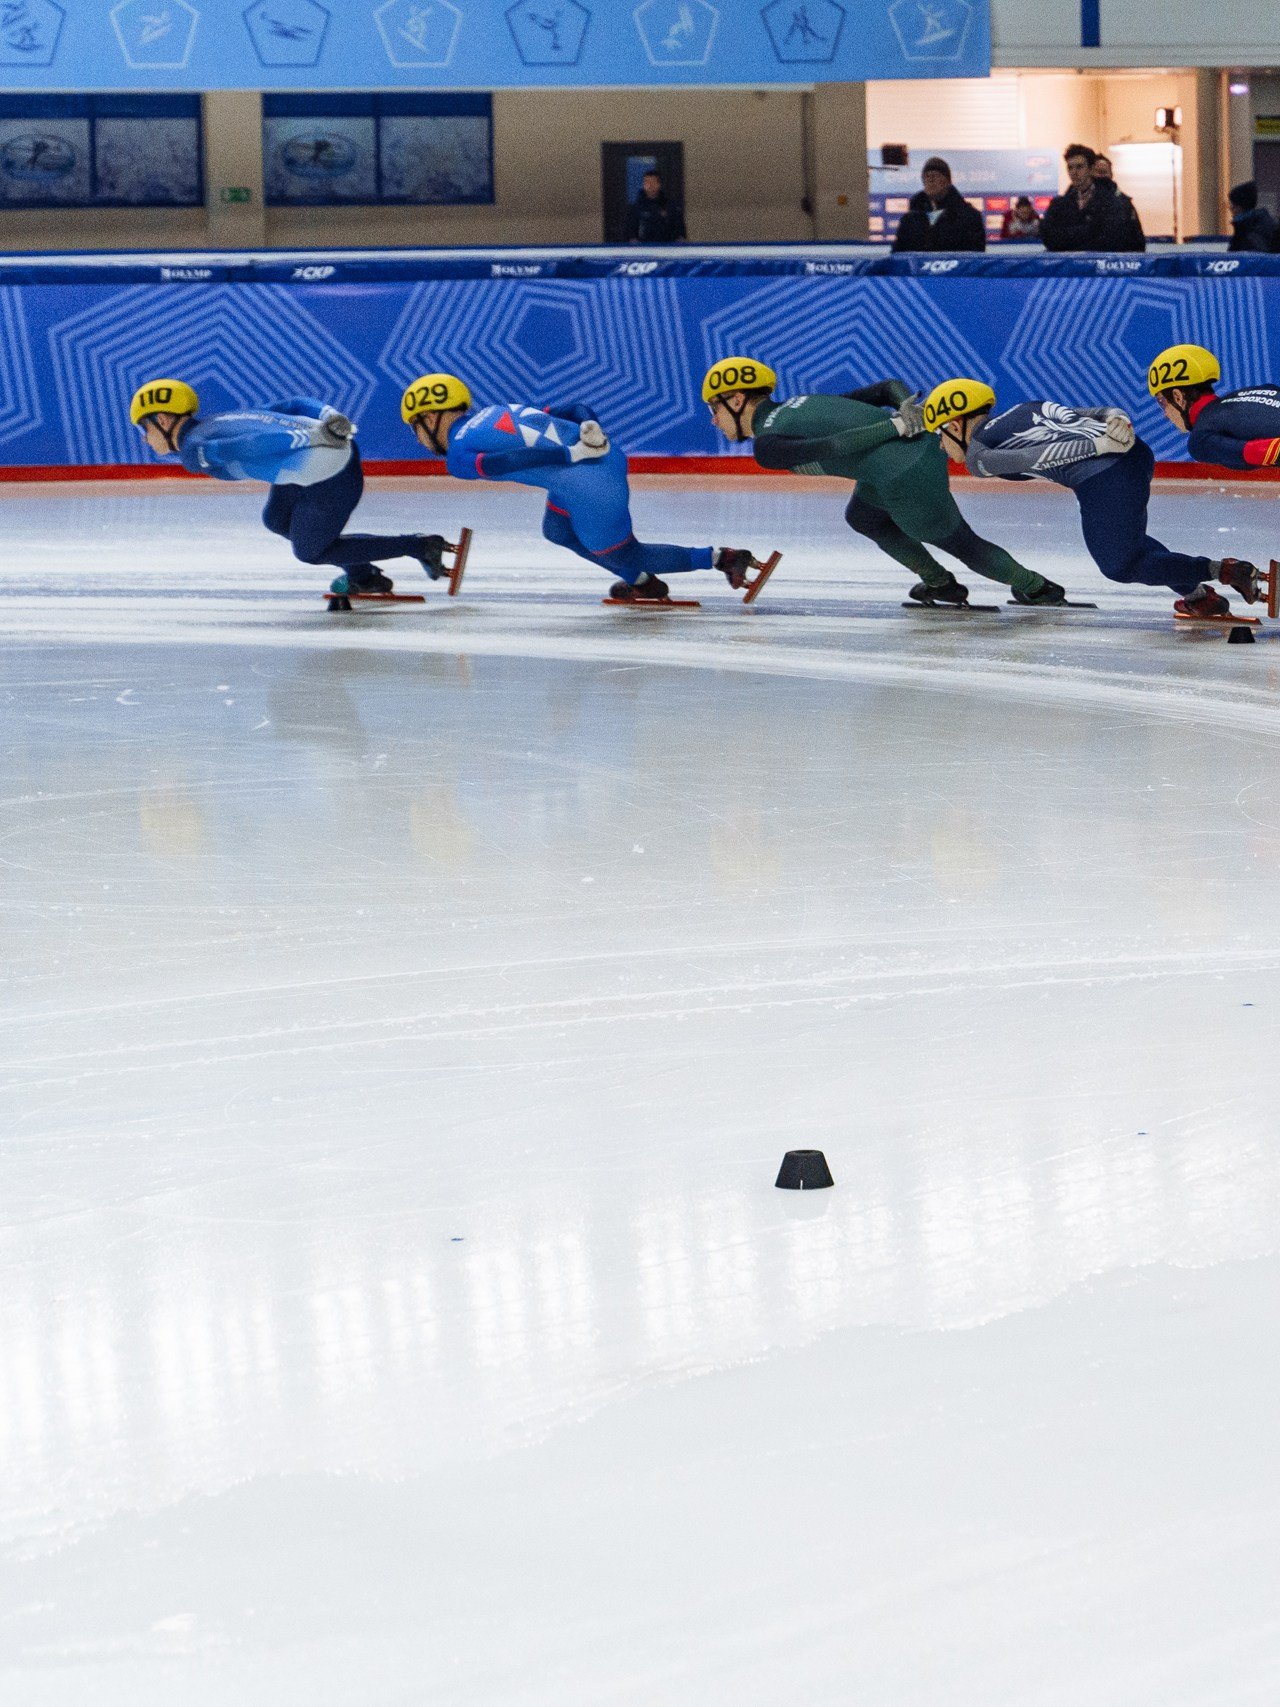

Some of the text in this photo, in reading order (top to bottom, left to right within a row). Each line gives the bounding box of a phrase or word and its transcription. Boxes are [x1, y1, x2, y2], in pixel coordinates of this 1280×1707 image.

[709, 365, 757, 391] 008
[1149, 358, 1190, 388] 022
[139, 387, 172, 408] 110
[404, 383, 449, 412] 029
[925, 390, 968, 424] 040
